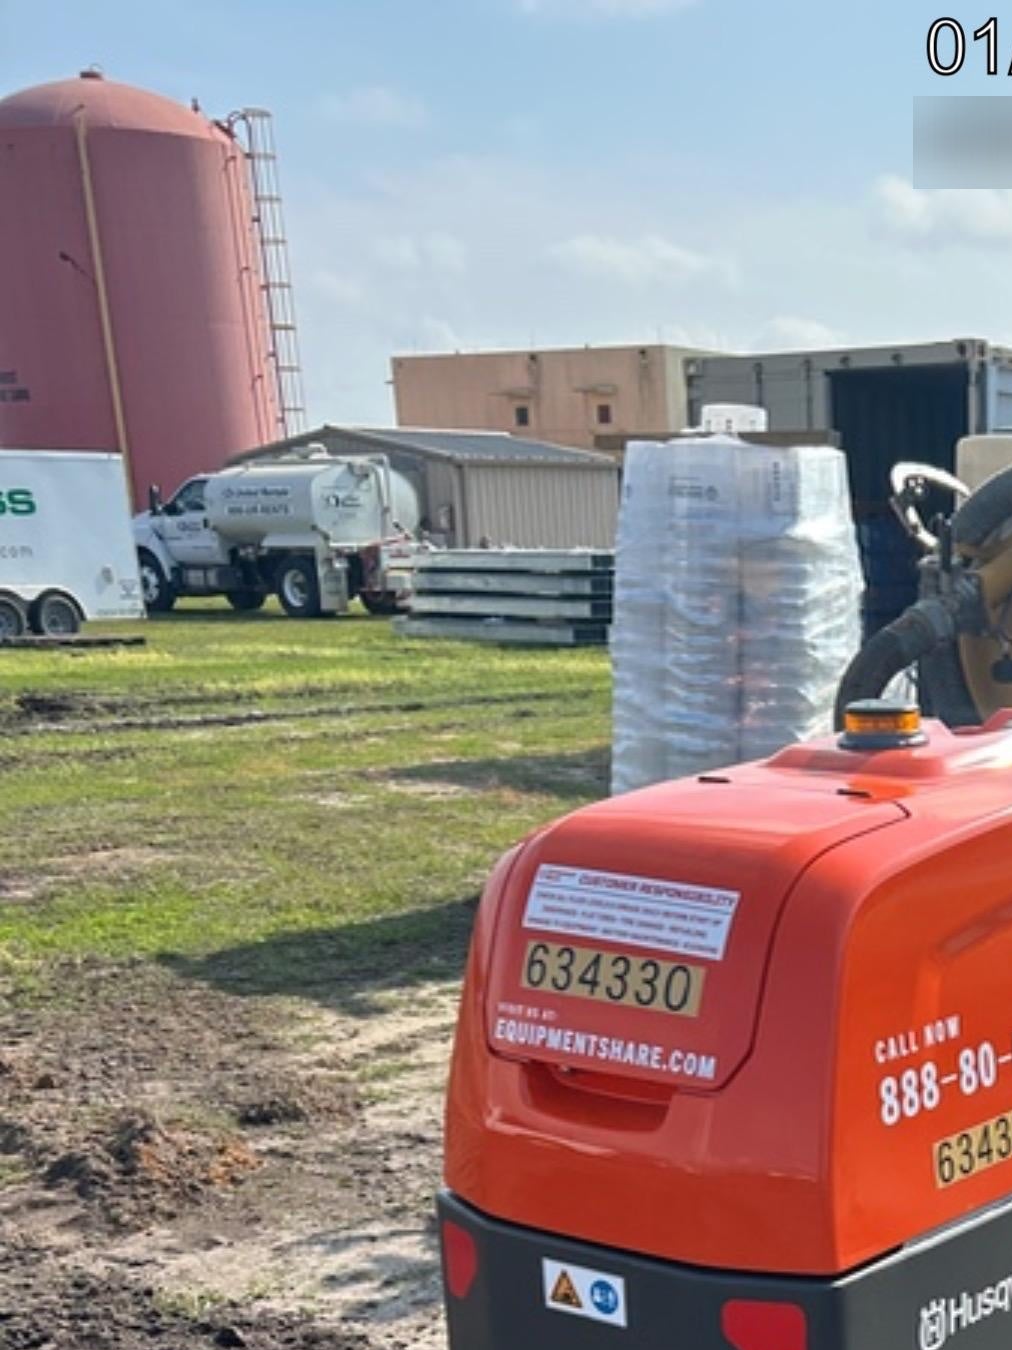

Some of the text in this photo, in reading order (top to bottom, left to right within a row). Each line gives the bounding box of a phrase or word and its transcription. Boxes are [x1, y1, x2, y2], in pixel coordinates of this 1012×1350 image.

[526, 943, 692, 1012] 634330
[494, 1017, 717, 1080] EQUIPMENTSHARE.COM
[874, 1014, 961, 1064] CALL NOW
